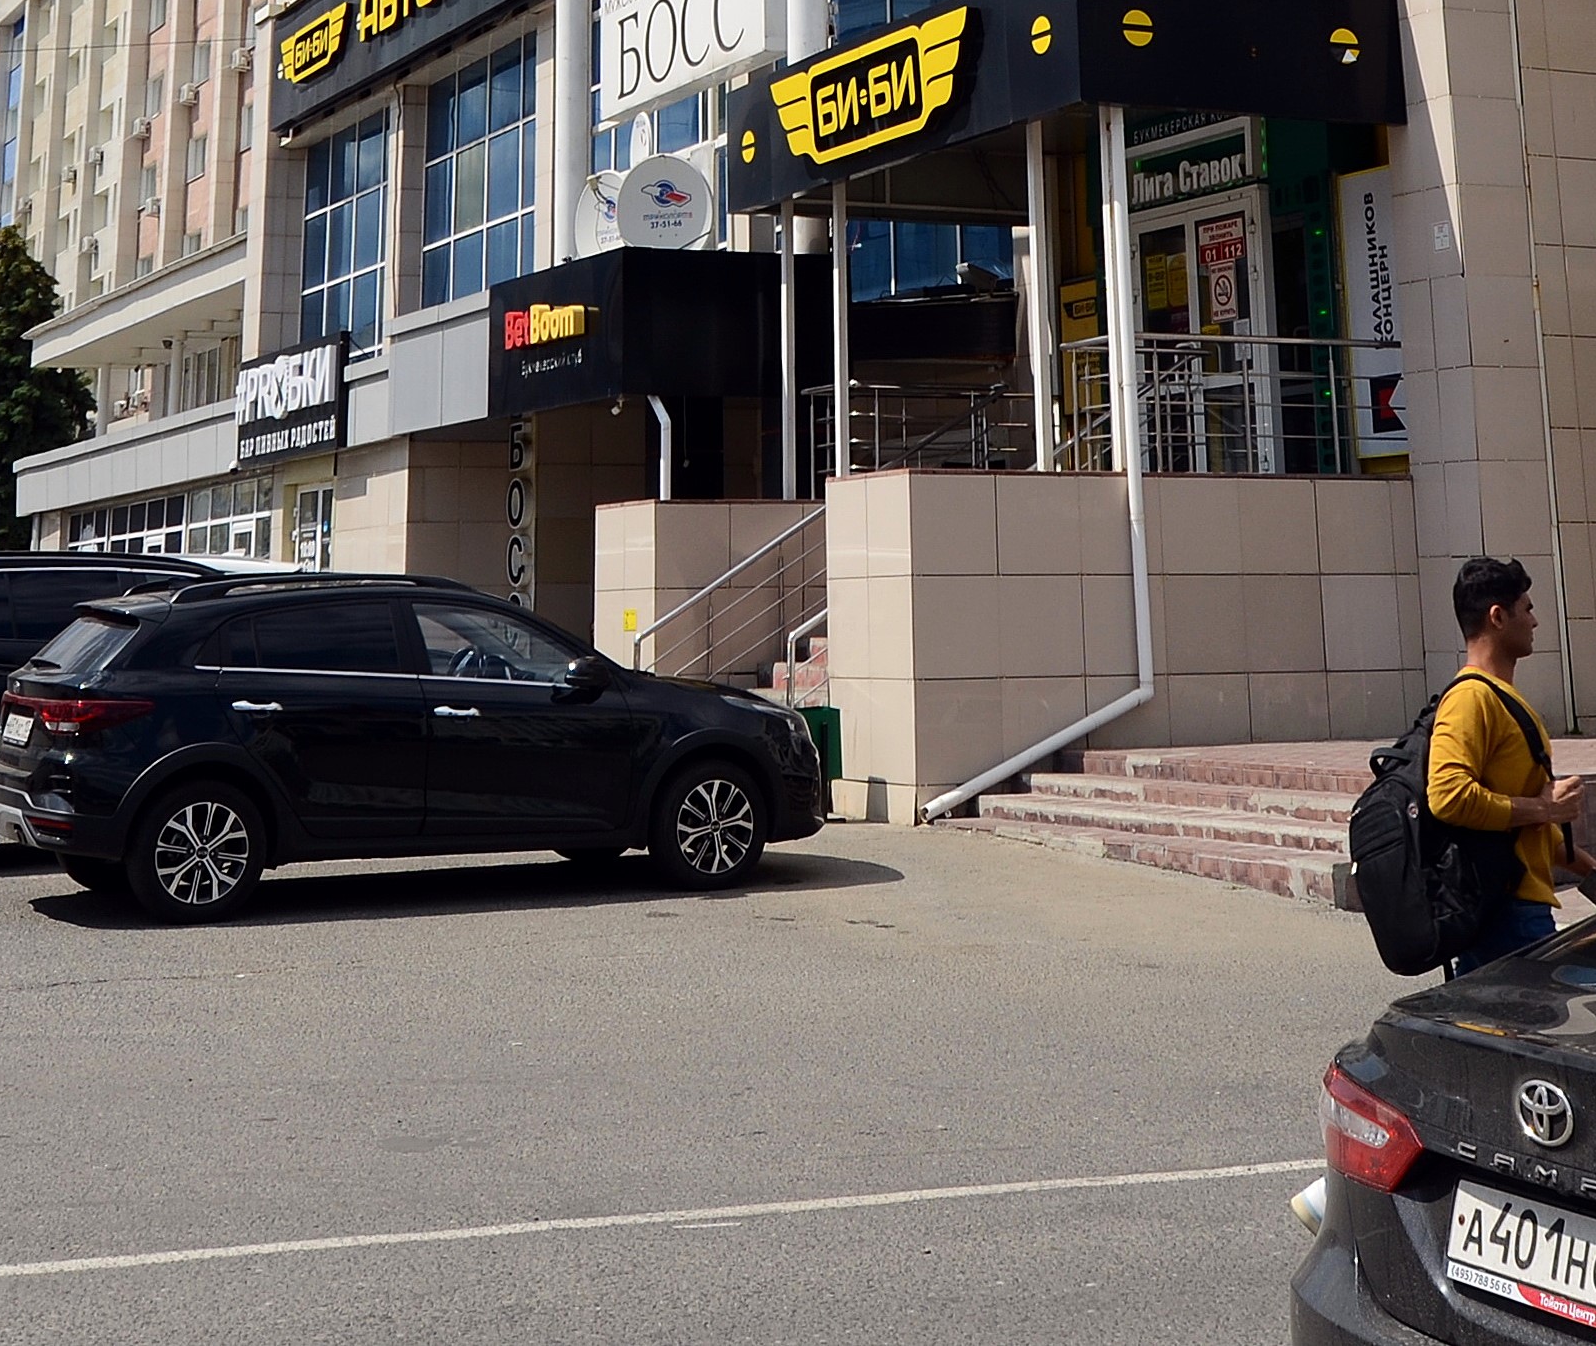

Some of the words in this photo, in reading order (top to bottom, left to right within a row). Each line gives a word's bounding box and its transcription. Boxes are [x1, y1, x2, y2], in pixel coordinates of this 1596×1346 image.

[1133, 112, 1206, 144] БУКМЕКЕРСКАЯ
[1132, 171, 1174, 205] Лига
[1178, 153, 1243, 194] Ставок
[1205, 249, 1217, 262] 01
[1225, 244, 1243, 258] 112
[505, 304, 579, 350] BetBoom
[239, 438, 255, 460] БАР
[255, 429, 289, 456] ПИВНЫХ
[290, 414, 336, 448] РАДОСТЕЙ
[1450, 1263, 1474, 1283] (495)
[1489, 1278, 1501, 1292] 56
[1502, 1282, 1512, 1296] 65
[1539, 1291, 1570, 1315] Тойота
